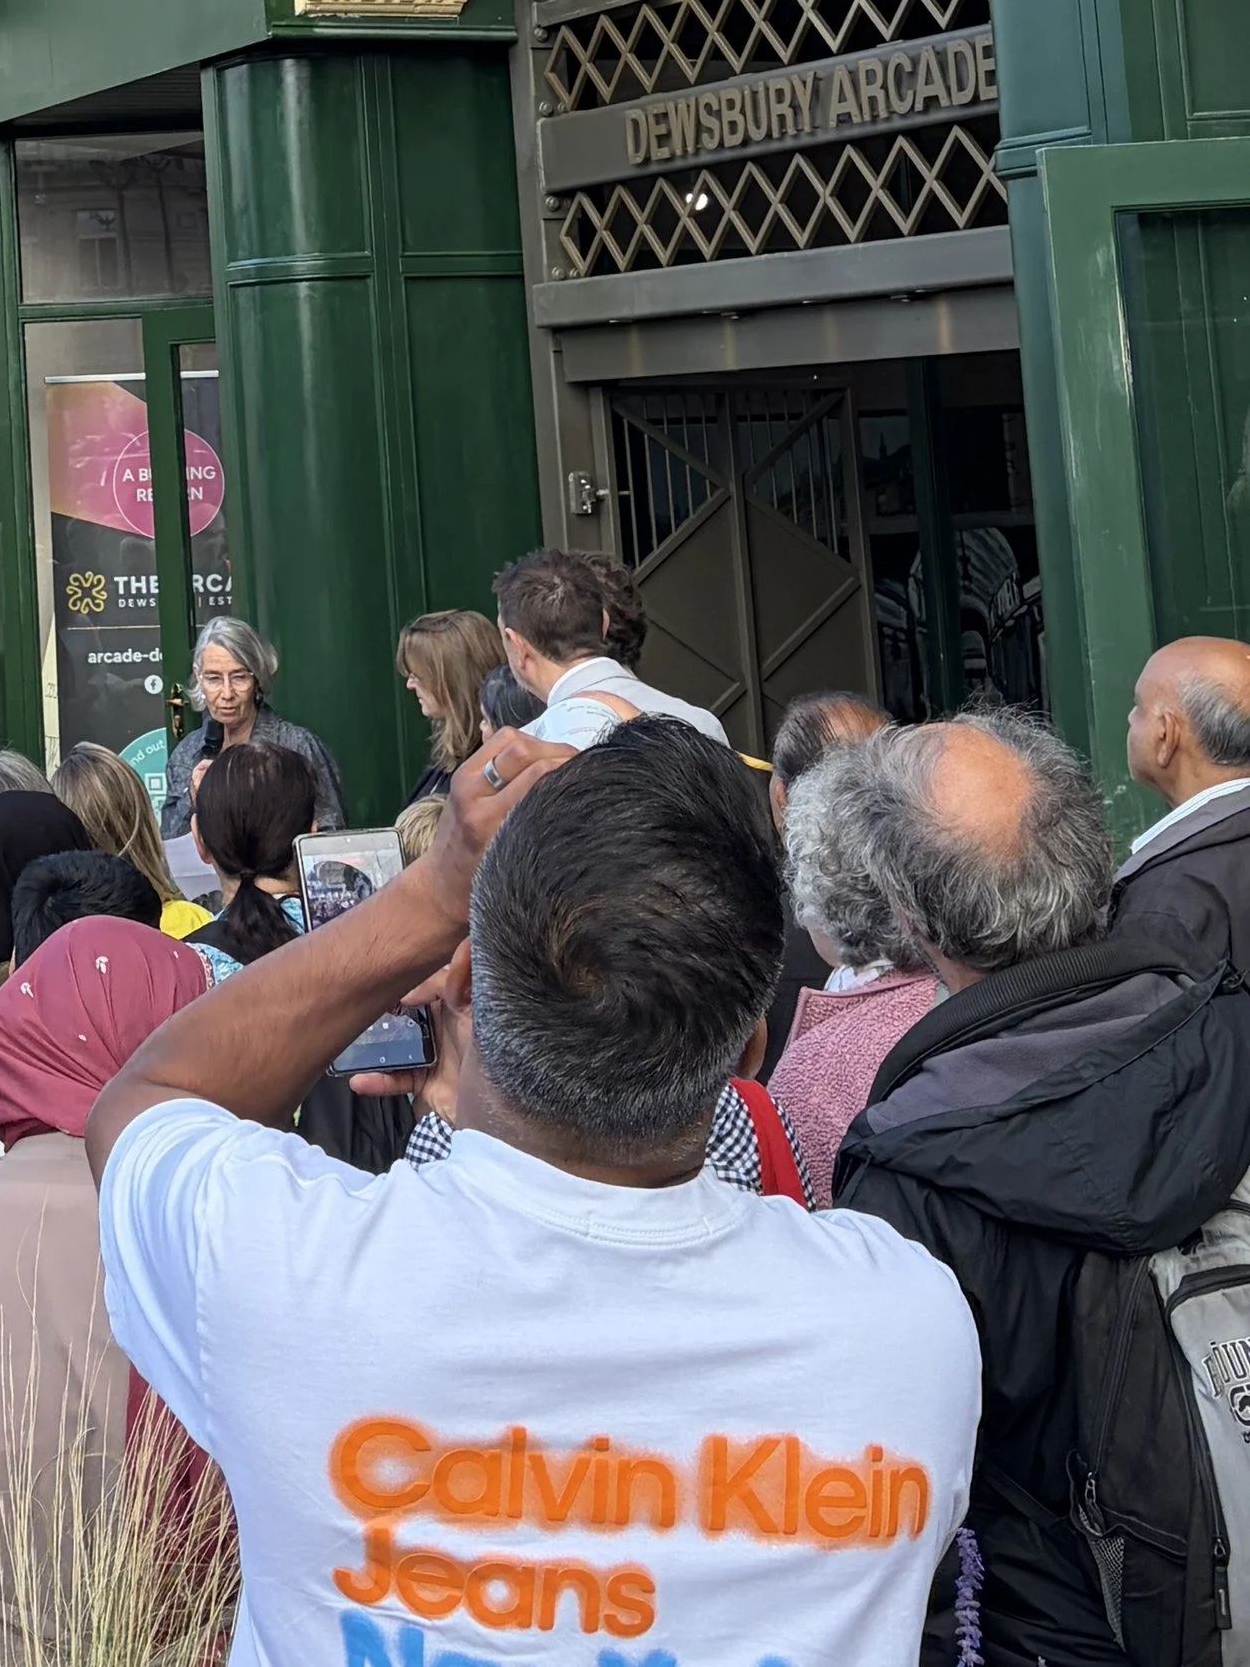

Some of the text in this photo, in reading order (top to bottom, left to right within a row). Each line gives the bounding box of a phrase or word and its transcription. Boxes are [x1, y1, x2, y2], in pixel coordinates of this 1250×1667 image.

[625, 35, 998, 165] DEWSBURY ARCADE
[122, 468, 135, 482] A
[113, 575, 159, 594] THE
[332, 1417, 929, 1540] Calvin Klein
[332, 1526, 655, 1637] Jeans
